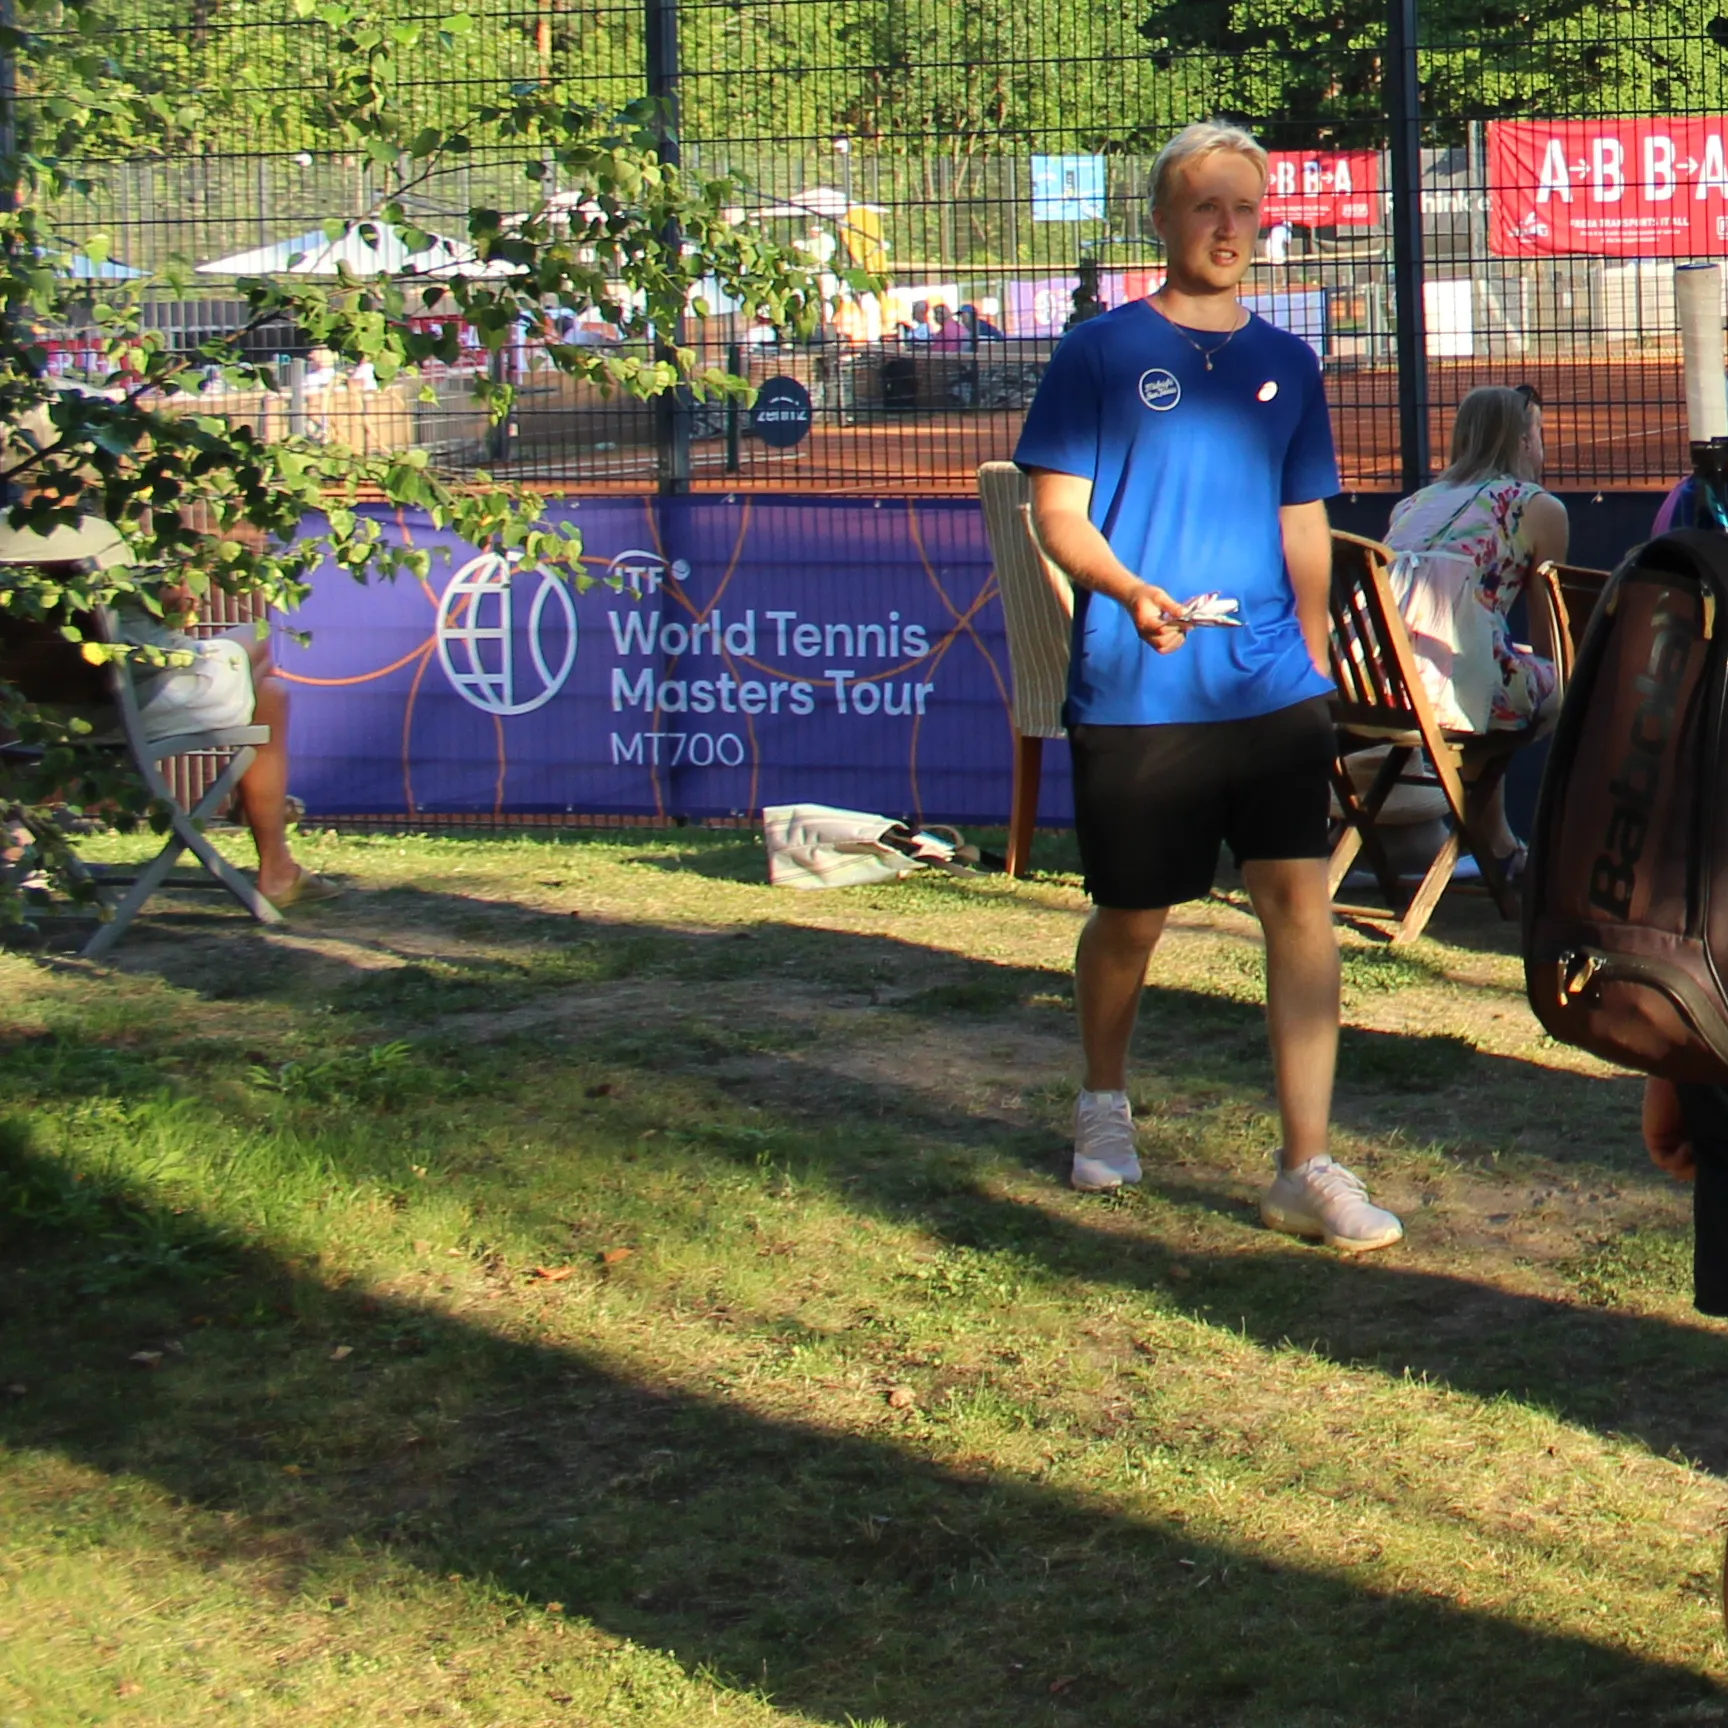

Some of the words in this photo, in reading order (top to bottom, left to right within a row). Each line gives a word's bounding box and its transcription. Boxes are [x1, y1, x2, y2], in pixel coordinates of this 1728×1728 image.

[1385, 189, 1473, 214] Rhink
[613, 565, 665, 595] ITF
[607, 609, 756, 657] World
[765, 610, 931, 659] Tennis
[610, 666, 816, 715] Masters
[824, 669, 934, 715] Tour
[609, 732, 745, 766] MT700
[1588, 590, 1696, 922] Babolat
